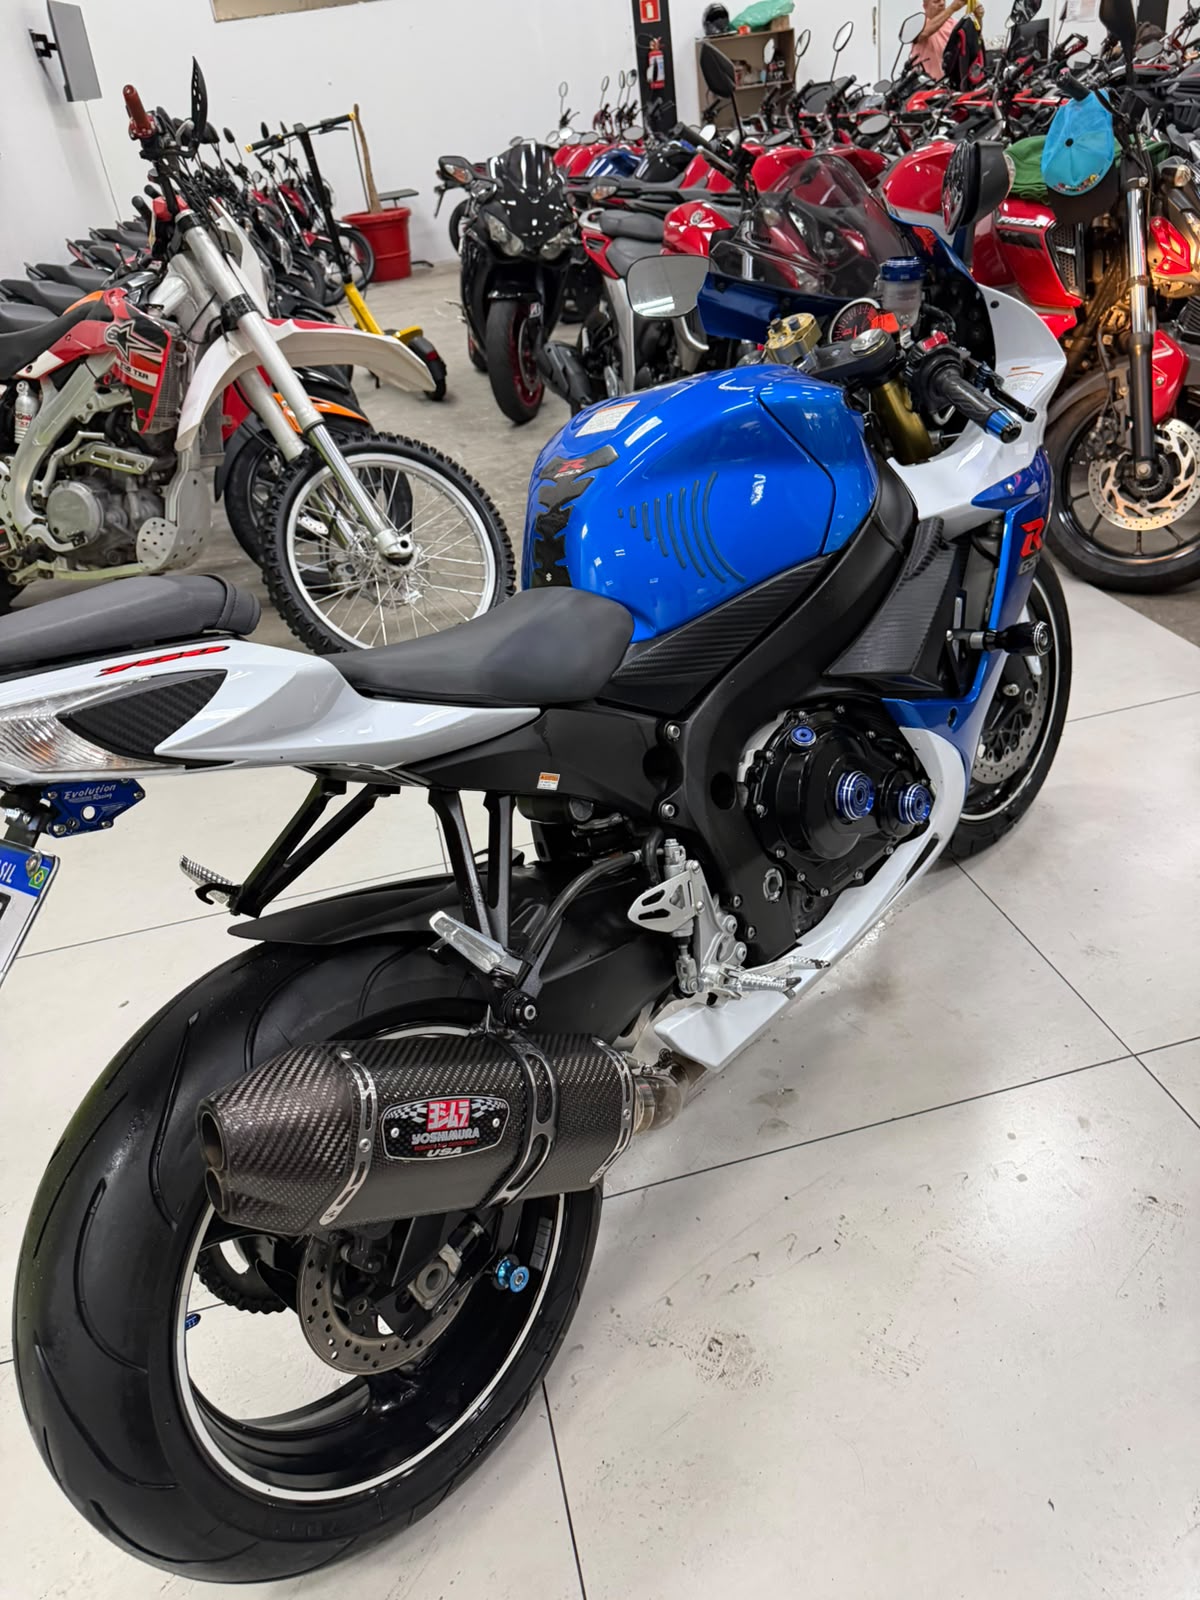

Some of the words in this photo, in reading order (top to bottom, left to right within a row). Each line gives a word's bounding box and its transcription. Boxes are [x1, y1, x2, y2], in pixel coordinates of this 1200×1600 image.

[63, 784, 117, 800] Evolution
[0, 859, 16, 883] SIL
[411, 1127, 481, 1145] YOSHIMURA
[426, 1146, 463, 1158] USA
